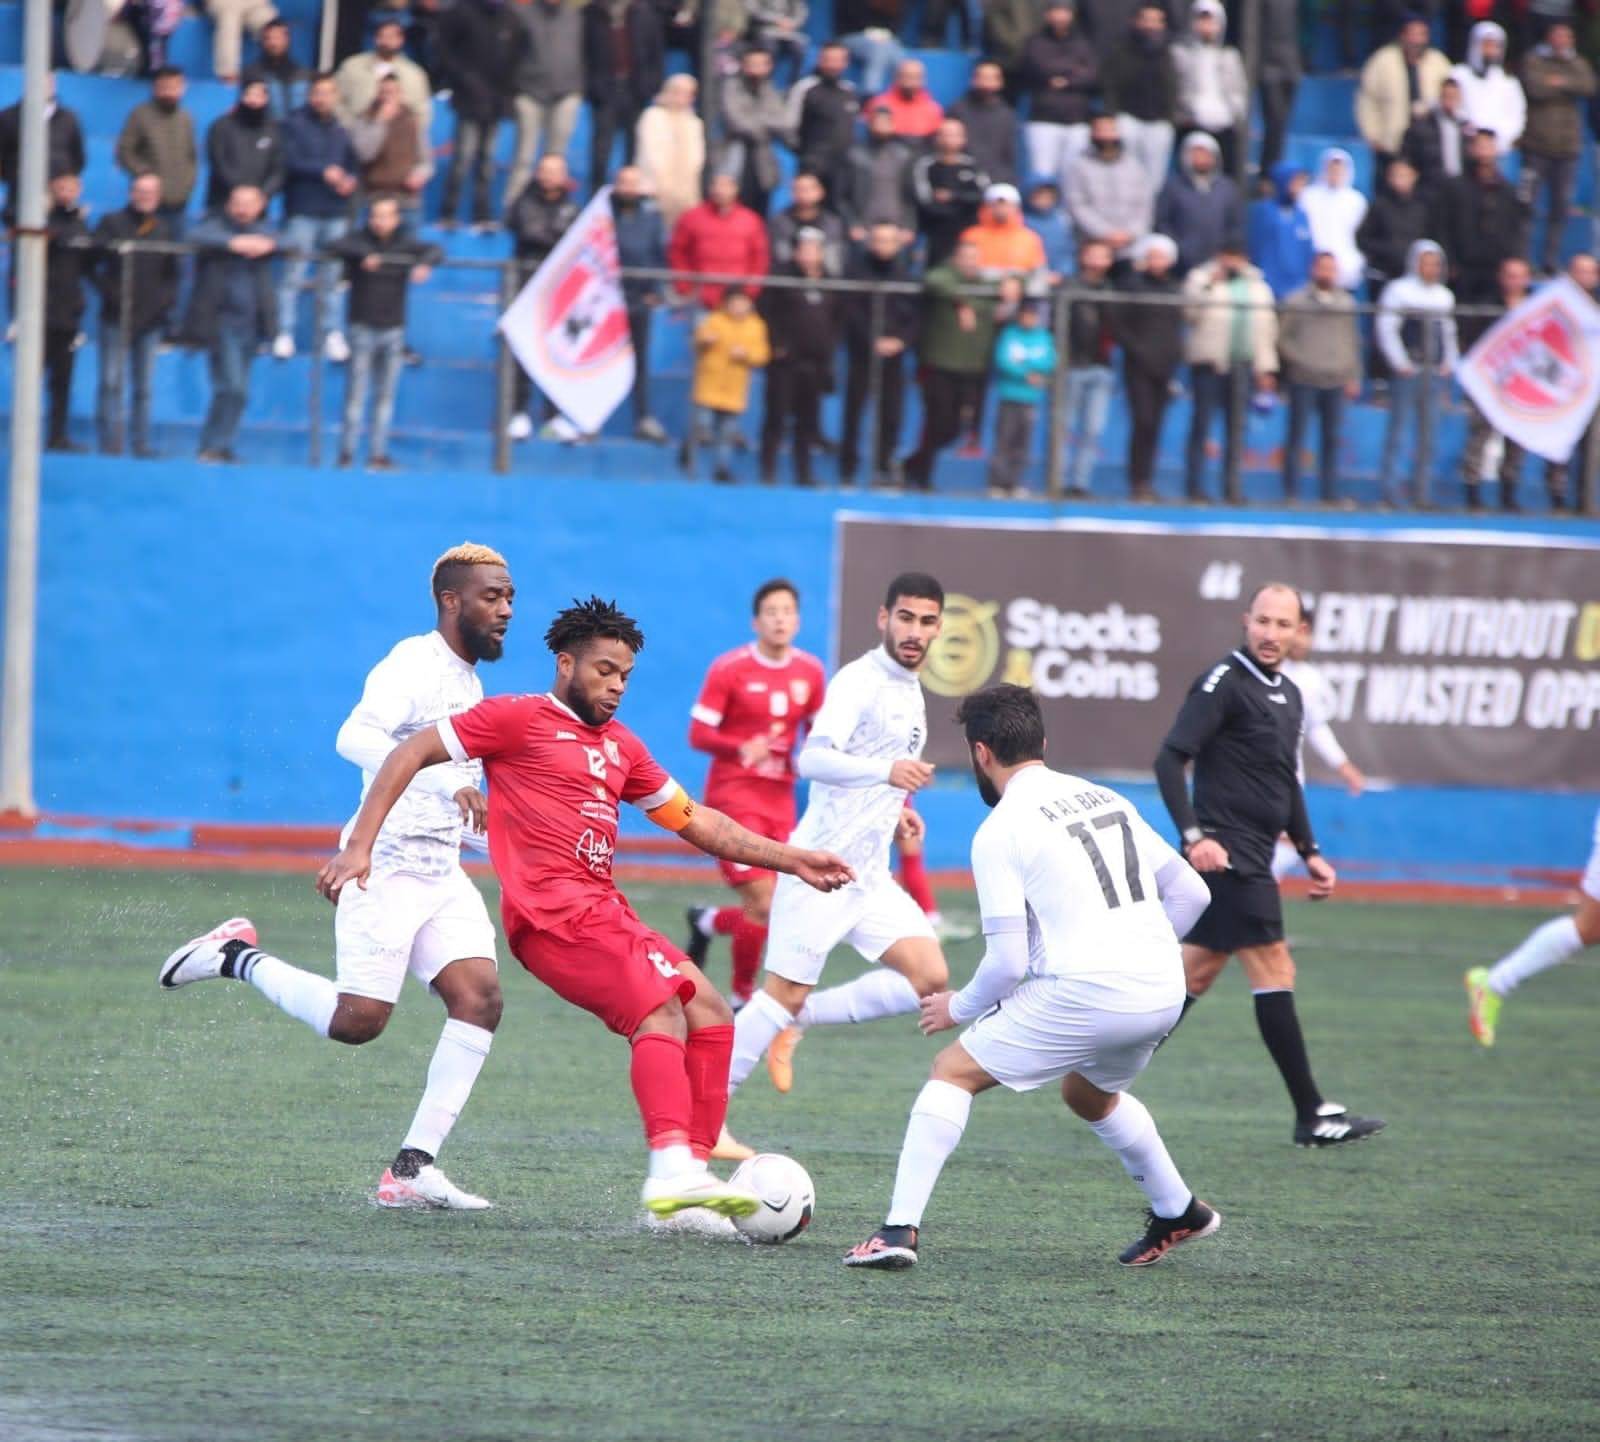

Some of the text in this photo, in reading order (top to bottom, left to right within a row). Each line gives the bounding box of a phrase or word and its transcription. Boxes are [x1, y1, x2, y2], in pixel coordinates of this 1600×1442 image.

[1005, 597, 1161, 653] Stocks
[1397, 595, 1577, 661] WITHOUT
[1032, 649, 1159, 701] Coins
[1365, 663, 1524, 728] WASTED
[582, 745, 608, 781] 12
[1039, 806, 1059, 822] A
[1065, 810, 1146, 910] 17
